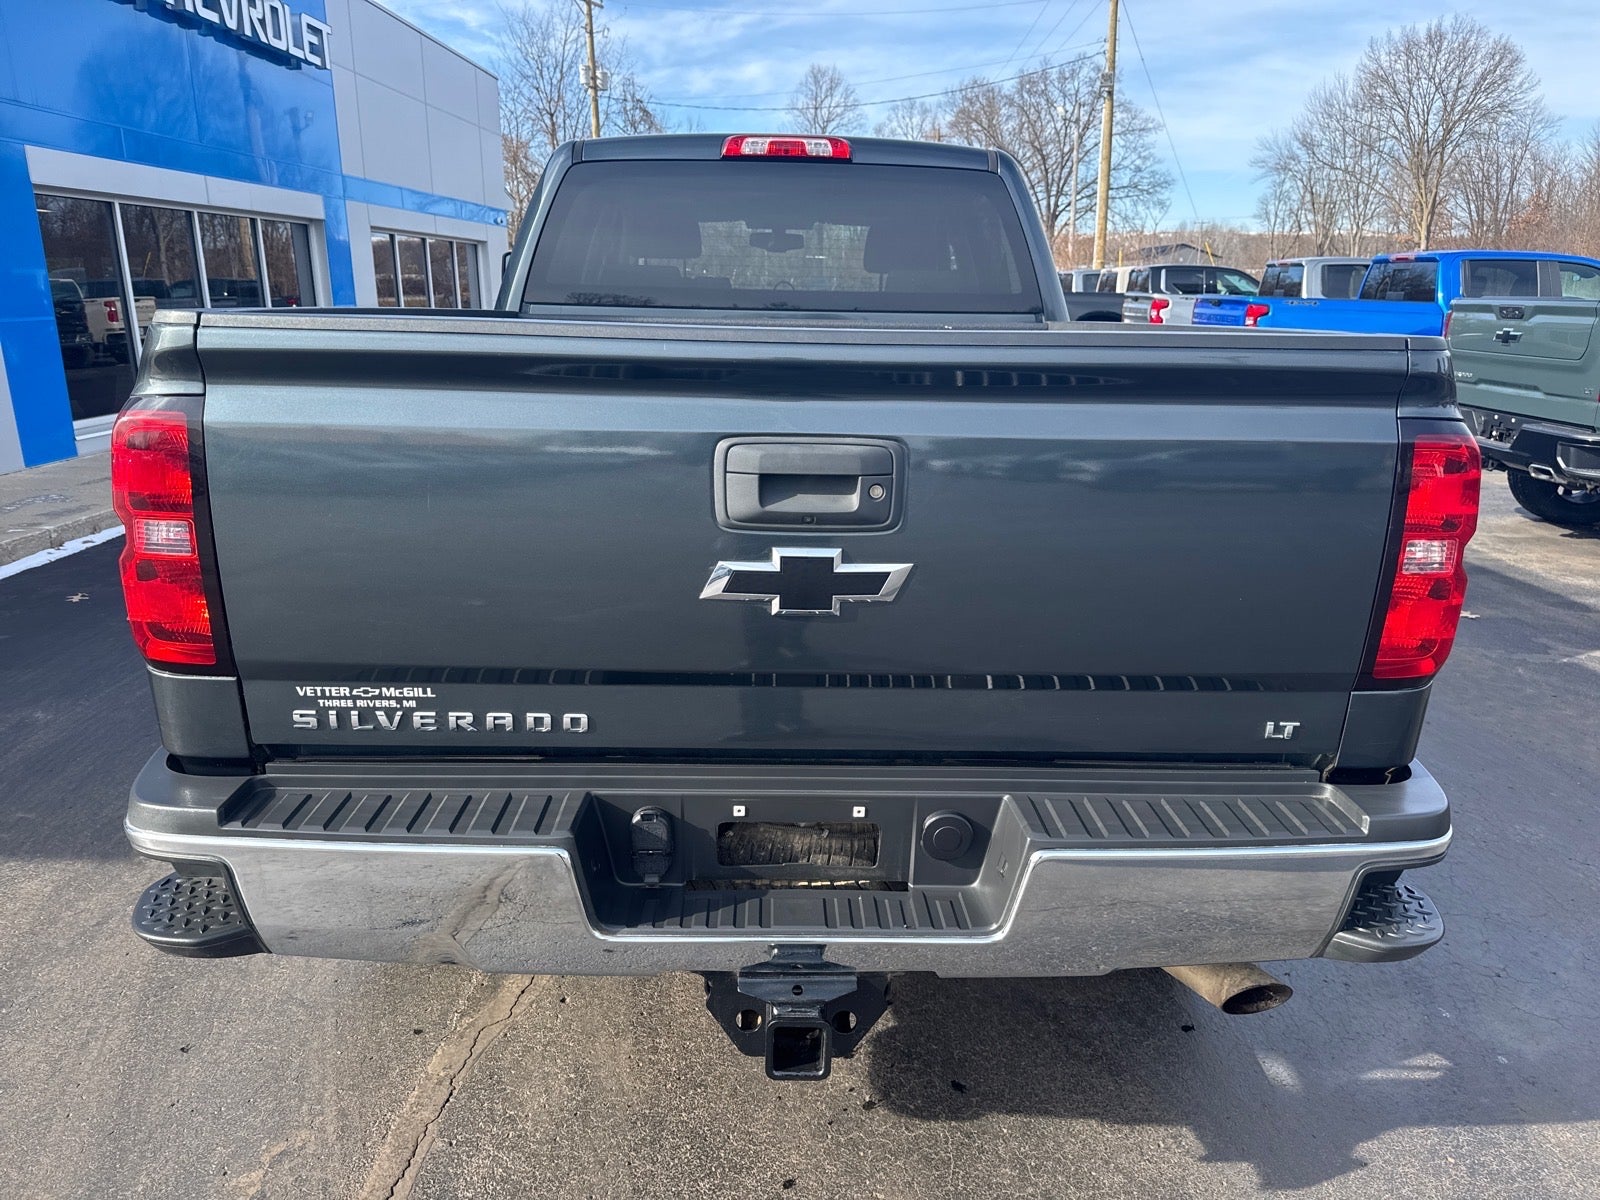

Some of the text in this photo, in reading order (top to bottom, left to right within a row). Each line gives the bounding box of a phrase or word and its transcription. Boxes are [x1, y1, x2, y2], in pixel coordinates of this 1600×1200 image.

[295, 686, 437, 698] VETTER McGILL
[317, 699, 417, 709] THREE RIVERS, MI
[292, 709, 589, 733] SILVERADO
[1264, 721, 1301, 740] LT
